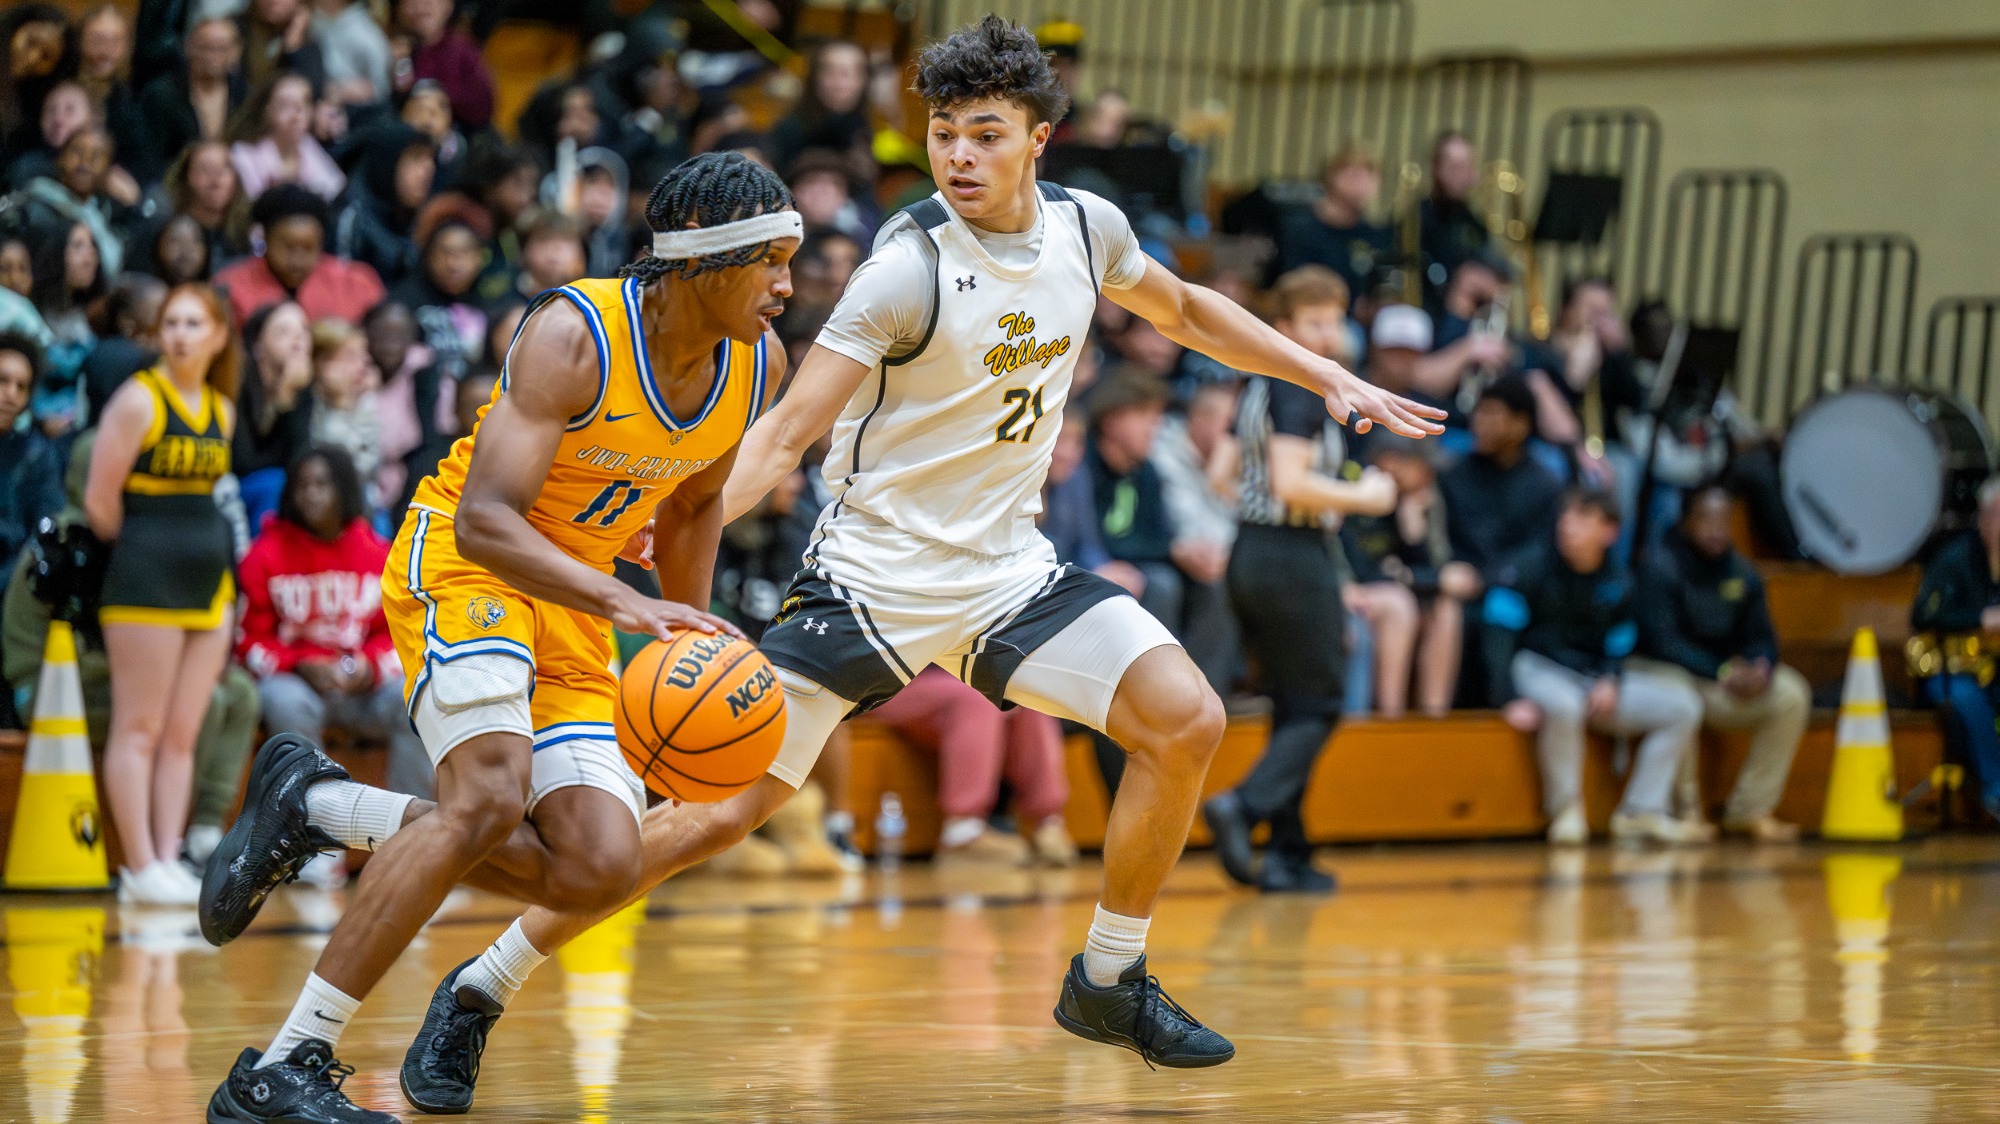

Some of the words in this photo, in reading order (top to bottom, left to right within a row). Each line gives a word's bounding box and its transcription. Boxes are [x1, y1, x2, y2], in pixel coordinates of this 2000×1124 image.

[998, 311, 1036, 340] The
[984, 336, 1071, 376] Village
[995, 385, 1045, 443] 21
[571, 479, 650, 528] 11
[664, 633, 736, 690] Wilso
[725, 664, 777, 719] NCAA
